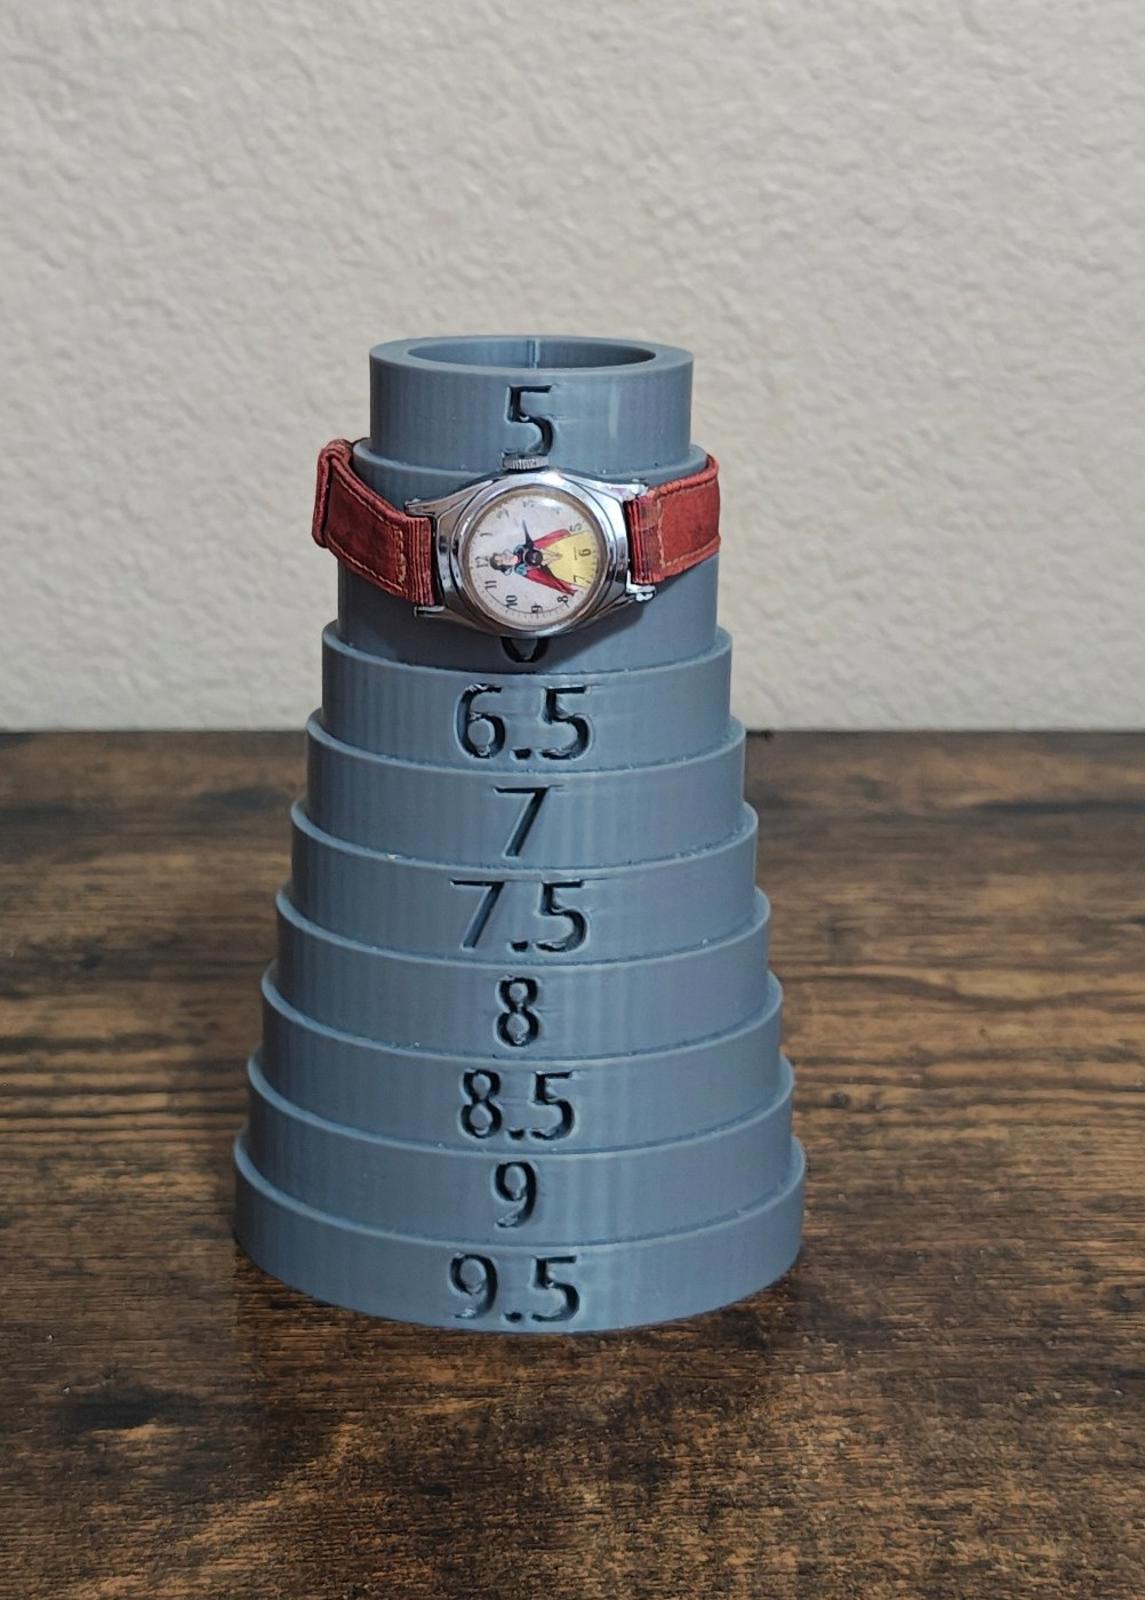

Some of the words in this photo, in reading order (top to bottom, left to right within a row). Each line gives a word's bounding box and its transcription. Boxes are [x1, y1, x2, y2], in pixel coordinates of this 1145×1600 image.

[505, 384, 554, 456] 5
[569, 523, 583, 532] 5
[476, 556, 489, 568] 12
[578, 548, 592, 557] 6
[485, 580, 497, 589] 11
[557, 595, 569, 604] 8
[573, 575, 591, 584] 7
[505, 595, 518, 609] 10
[531, 605, 543, 613] 9
[456, 683, 590, 760] 6.5
[493, 786, 549, 858] 7
[450, 880, 587, 952] 7.5
[495, 976, 540, 1047] 8
[459, 1068, 576, 1140] 8.5
[494, 1161, 537, 1229] 9
[449, 1253, 580, 1322] 9.5
